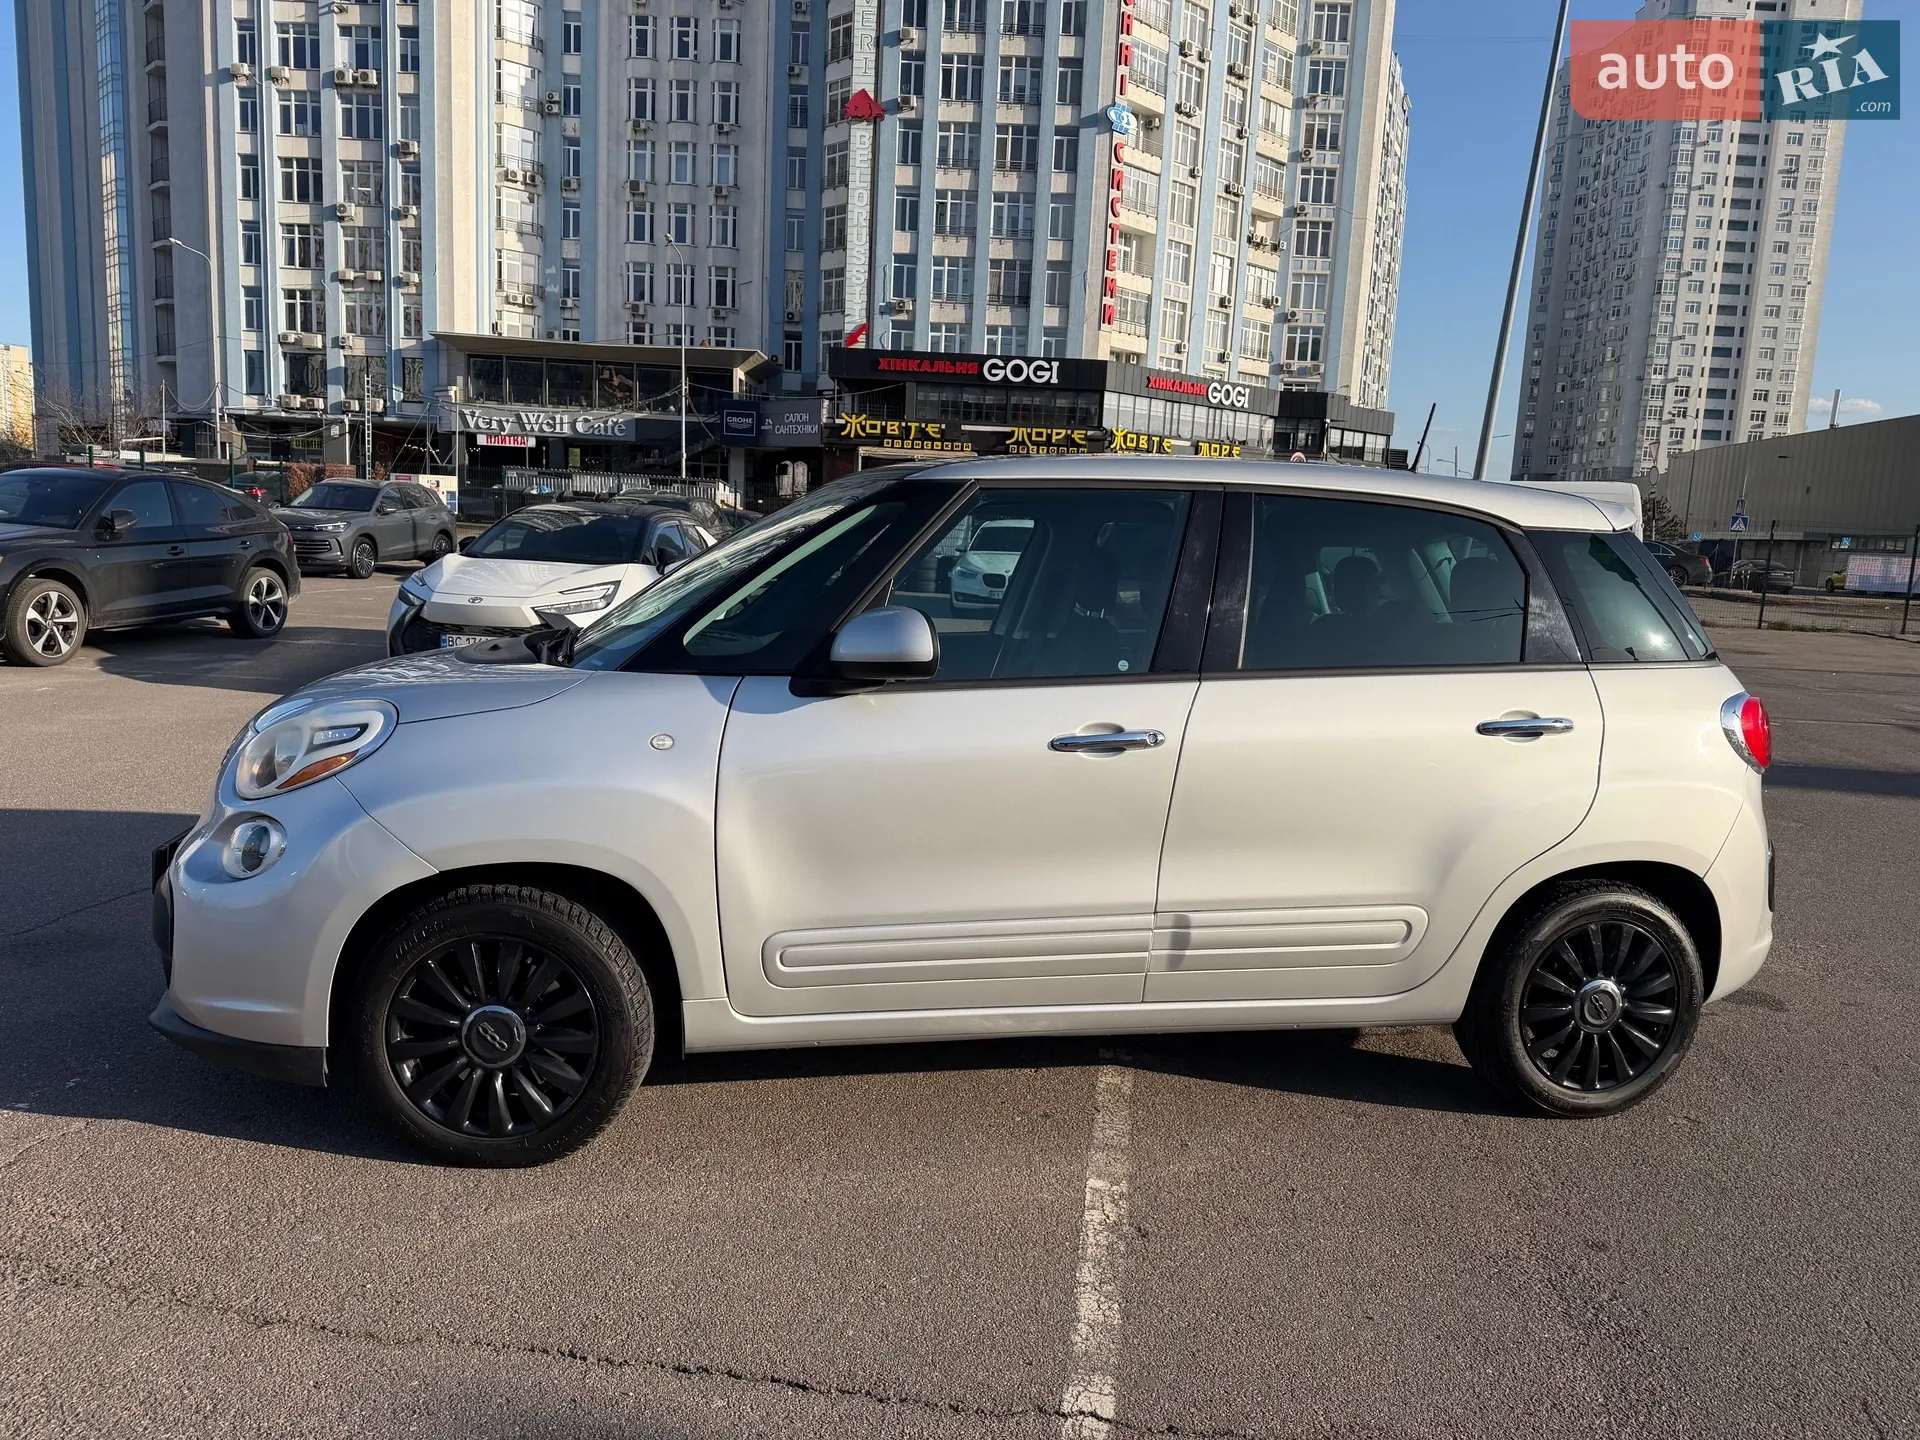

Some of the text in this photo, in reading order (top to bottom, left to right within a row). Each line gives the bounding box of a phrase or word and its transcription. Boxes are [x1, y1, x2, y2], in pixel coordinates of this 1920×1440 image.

[1102, 142, 1124, 325] СИСТЕМИ
[878, 358, 1060, 384] ХІНКАЛЬНЯ GOGI
[1148, 376, 1250, 409] ХІНКАЛЬНЯ GOGI
[461, 409, 626, 437] Very Well Café
[726, 416, 753, 424] GROHE
[784, 413, 809, 422] САЛОН
[775, 425, 819, 435] САНТЕХНІКИ
[486, 434, 526, 446] ПЛИТКА
